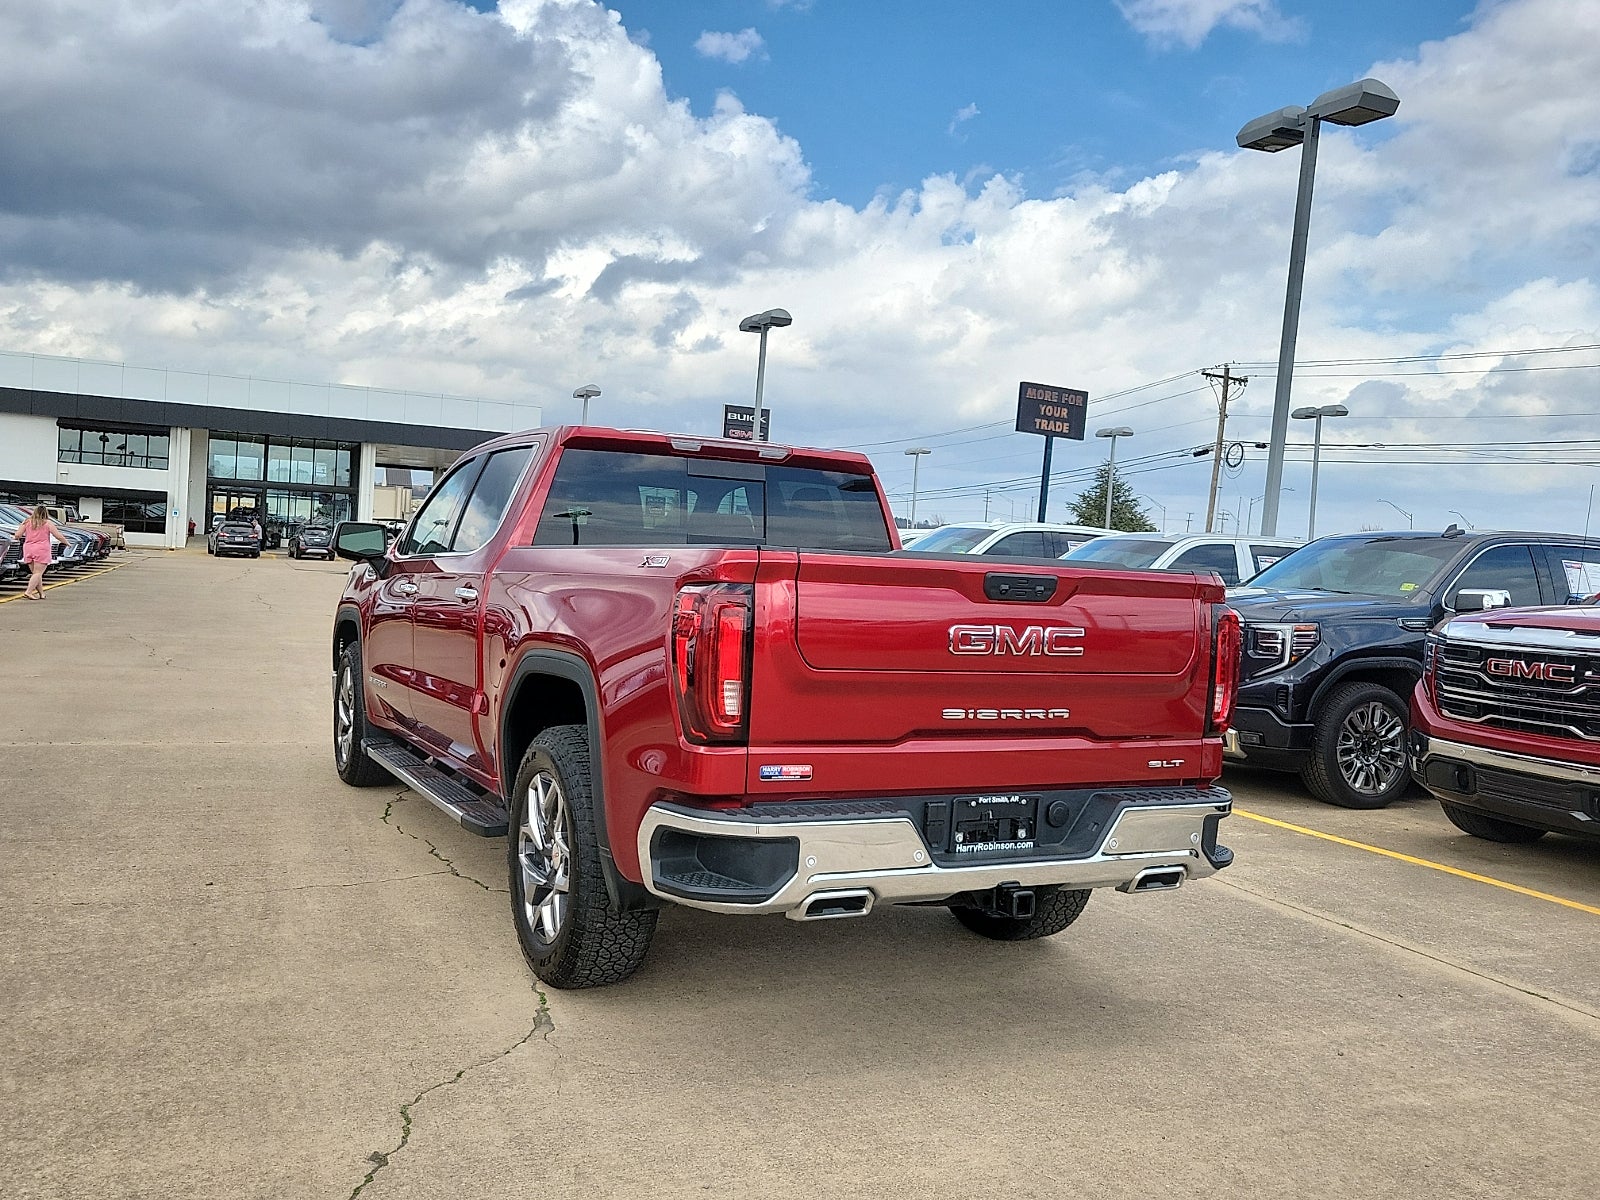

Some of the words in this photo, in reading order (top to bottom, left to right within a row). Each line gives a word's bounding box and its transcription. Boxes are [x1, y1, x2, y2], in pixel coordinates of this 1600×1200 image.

[1026, 387, 1059, 402] MORE
[1061, 392, 1083, 406] FOR
[1039, 404, 1068, 418] YOUR
[1034, 418, 1070, 433] TRADE
[948, 624, 1085, 656] GMC
[1487, 657, 1576, 683] GMC
[942, 708, 1070, 720] SIERRA
[1148, 760, 1185, 768] SLT
[978, 796, 992, 804] Fort
[955, 841, 1034, 853] HarryRobinson.com
